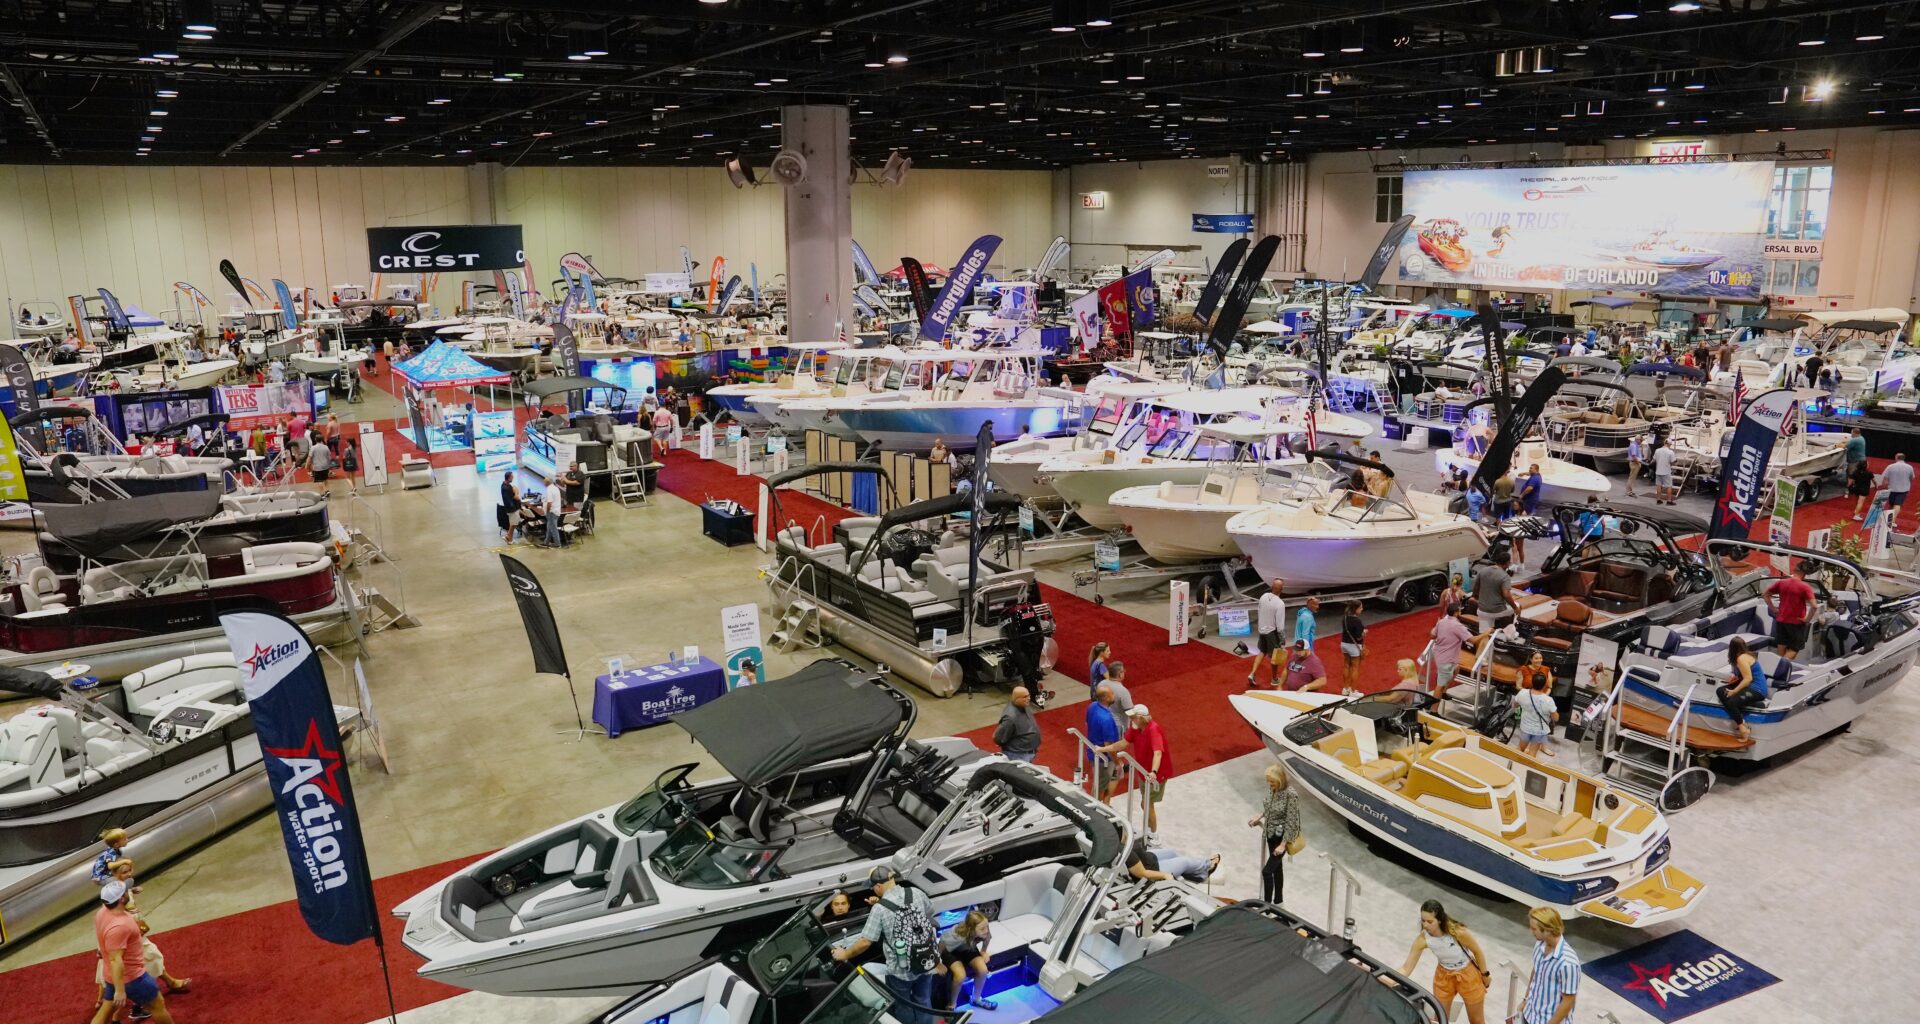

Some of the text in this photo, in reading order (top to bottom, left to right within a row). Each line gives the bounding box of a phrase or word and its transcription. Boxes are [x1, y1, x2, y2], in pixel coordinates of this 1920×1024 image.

[1659, 145, 1702, 163] EXIT
[1208, 167, 1229, 176] NORTH
[1083, 196, 1101, 207] EXIT
[1465, 211, 1511, 229] YOUR
[1764, 245, 1819, 253] ERSAL BLVD.
[378, 253, 480, 269] CREST
[1473, 264, 1488, 278] IN
[1491, 264, 1514, 279] THE
[1564, 266, 1585, 281] OF
[1587, 267, 1659, 286] ORLANDO
[931, 248, 987, 326] Everglades
[1488, 331, 1504, 396] NauticStar
[226, 393, 258, 408] TENS
[1755, 407, 1782, 418] Action
[1728, 444, 1758, 523] Action
[1750, 450, 1763, 495] water sports
[168, 616, 201, 624] CREST
[255, 639, 299, 673] Action
[184, 764, 219, 785] CREST
[1331, 785, 1389, 823] MasterCraft
[277, 757, 348, 890] Action
[287, 810, 325, 895] water sports
[1649, 953, 1737, 1002] Action
[1694, 965, 1744, 992] water sports
